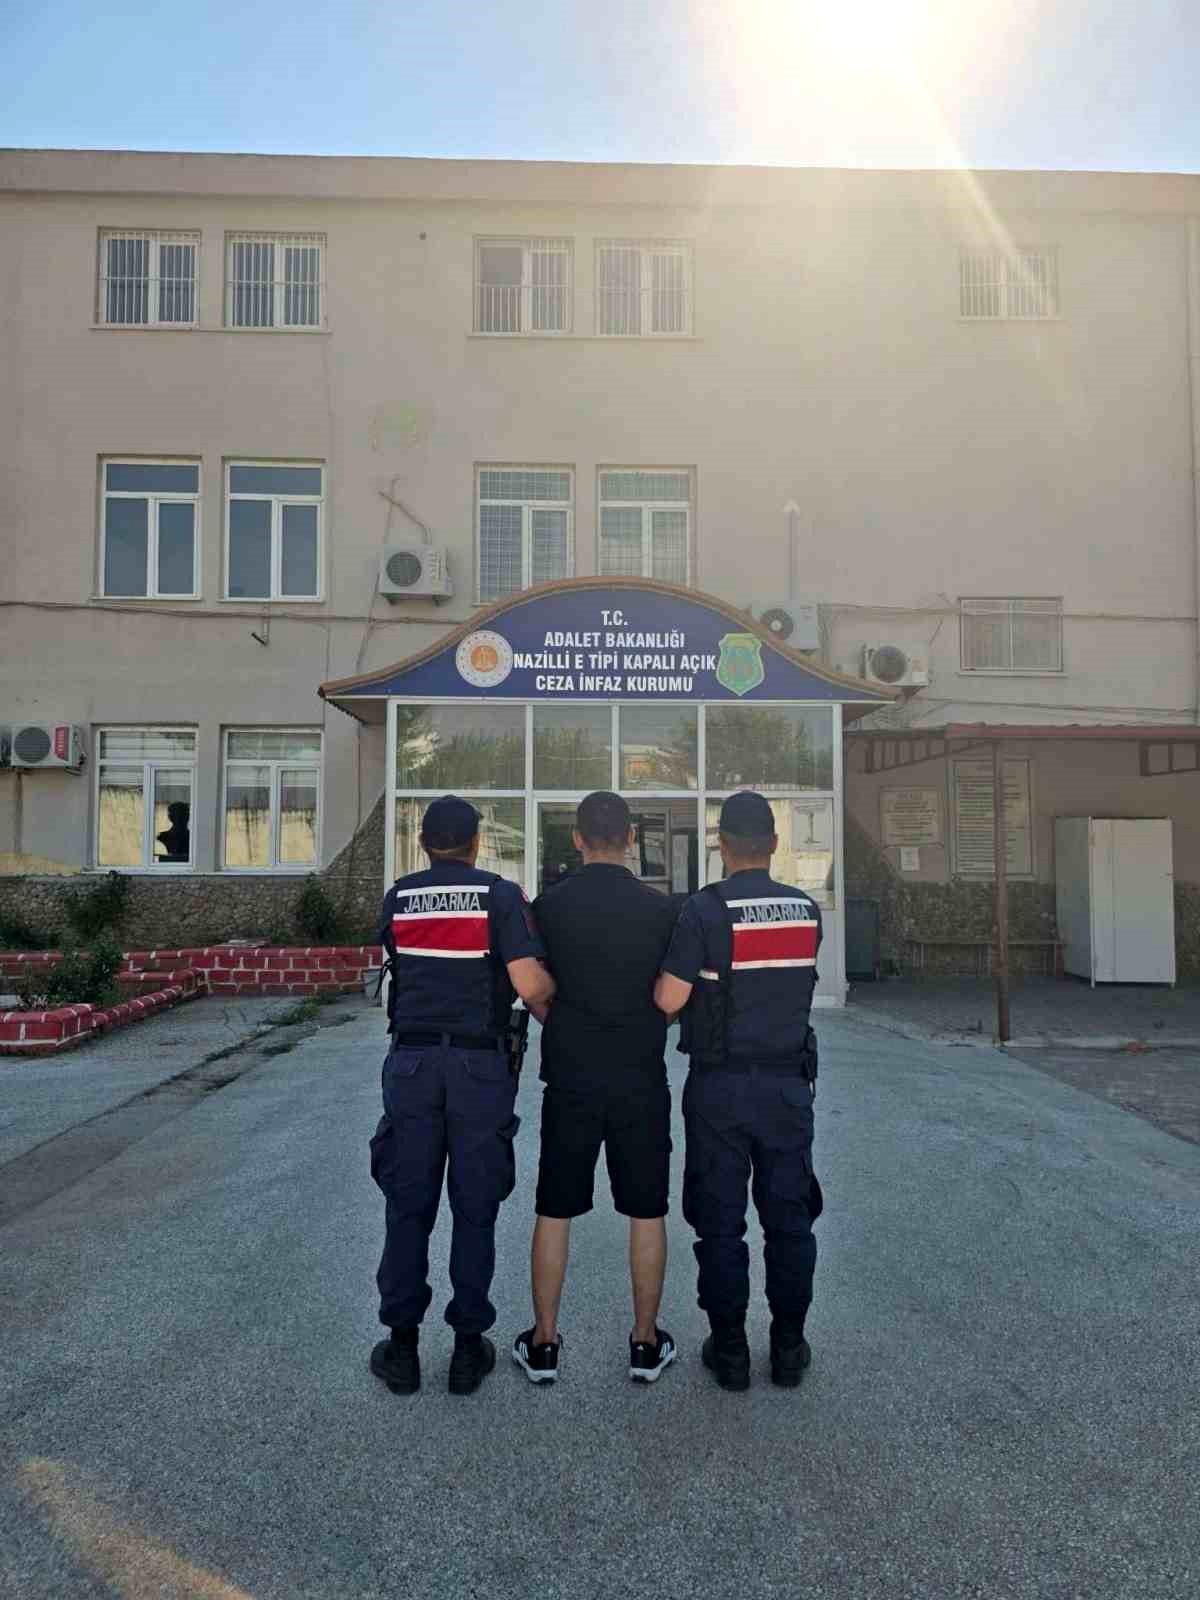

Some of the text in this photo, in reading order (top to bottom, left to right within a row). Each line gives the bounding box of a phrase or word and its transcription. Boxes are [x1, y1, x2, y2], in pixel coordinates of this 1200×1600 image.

[601, 610, 628, 626] T.C.
[544, 629, 685, 649] ADALET BAKANLIĞI
[513, 650, 716, 674] NAZİLLİ E TİPİ KAPALI AÇIK
[536, 672, 693, 692] CEZA İNFAZ KURUMU
[404, 892, 481, 913] JANDARMA
[740, 903, 811, 922] JANDARMA
